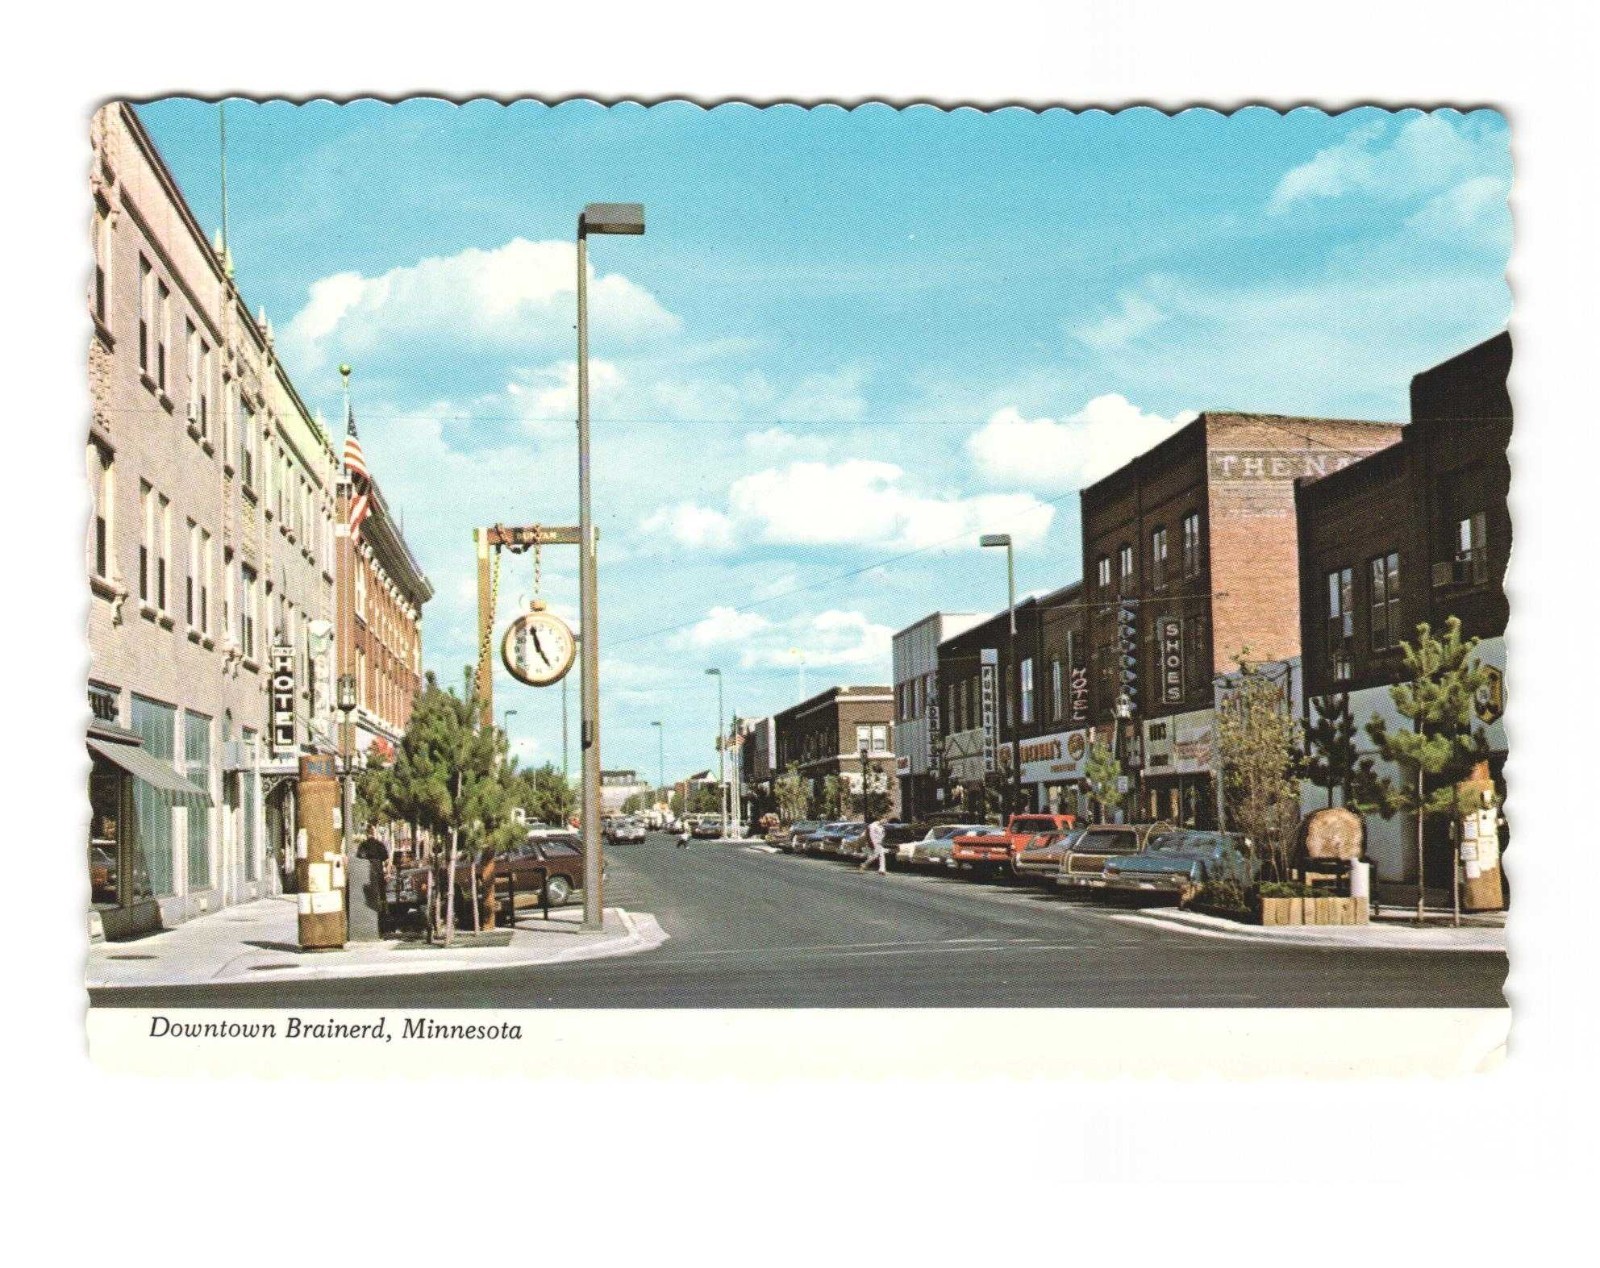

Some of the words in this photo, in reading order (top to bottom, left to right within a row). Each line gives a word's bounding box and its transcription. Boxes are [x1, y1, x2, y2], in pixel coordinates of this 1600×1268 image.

[1216, 455, 1292, 477] THE
[273, 656, 295, 743] HOTEL
[1165, 622, 1181, 700] SHOES
[983, 667, 993, 771] FURNITURE
